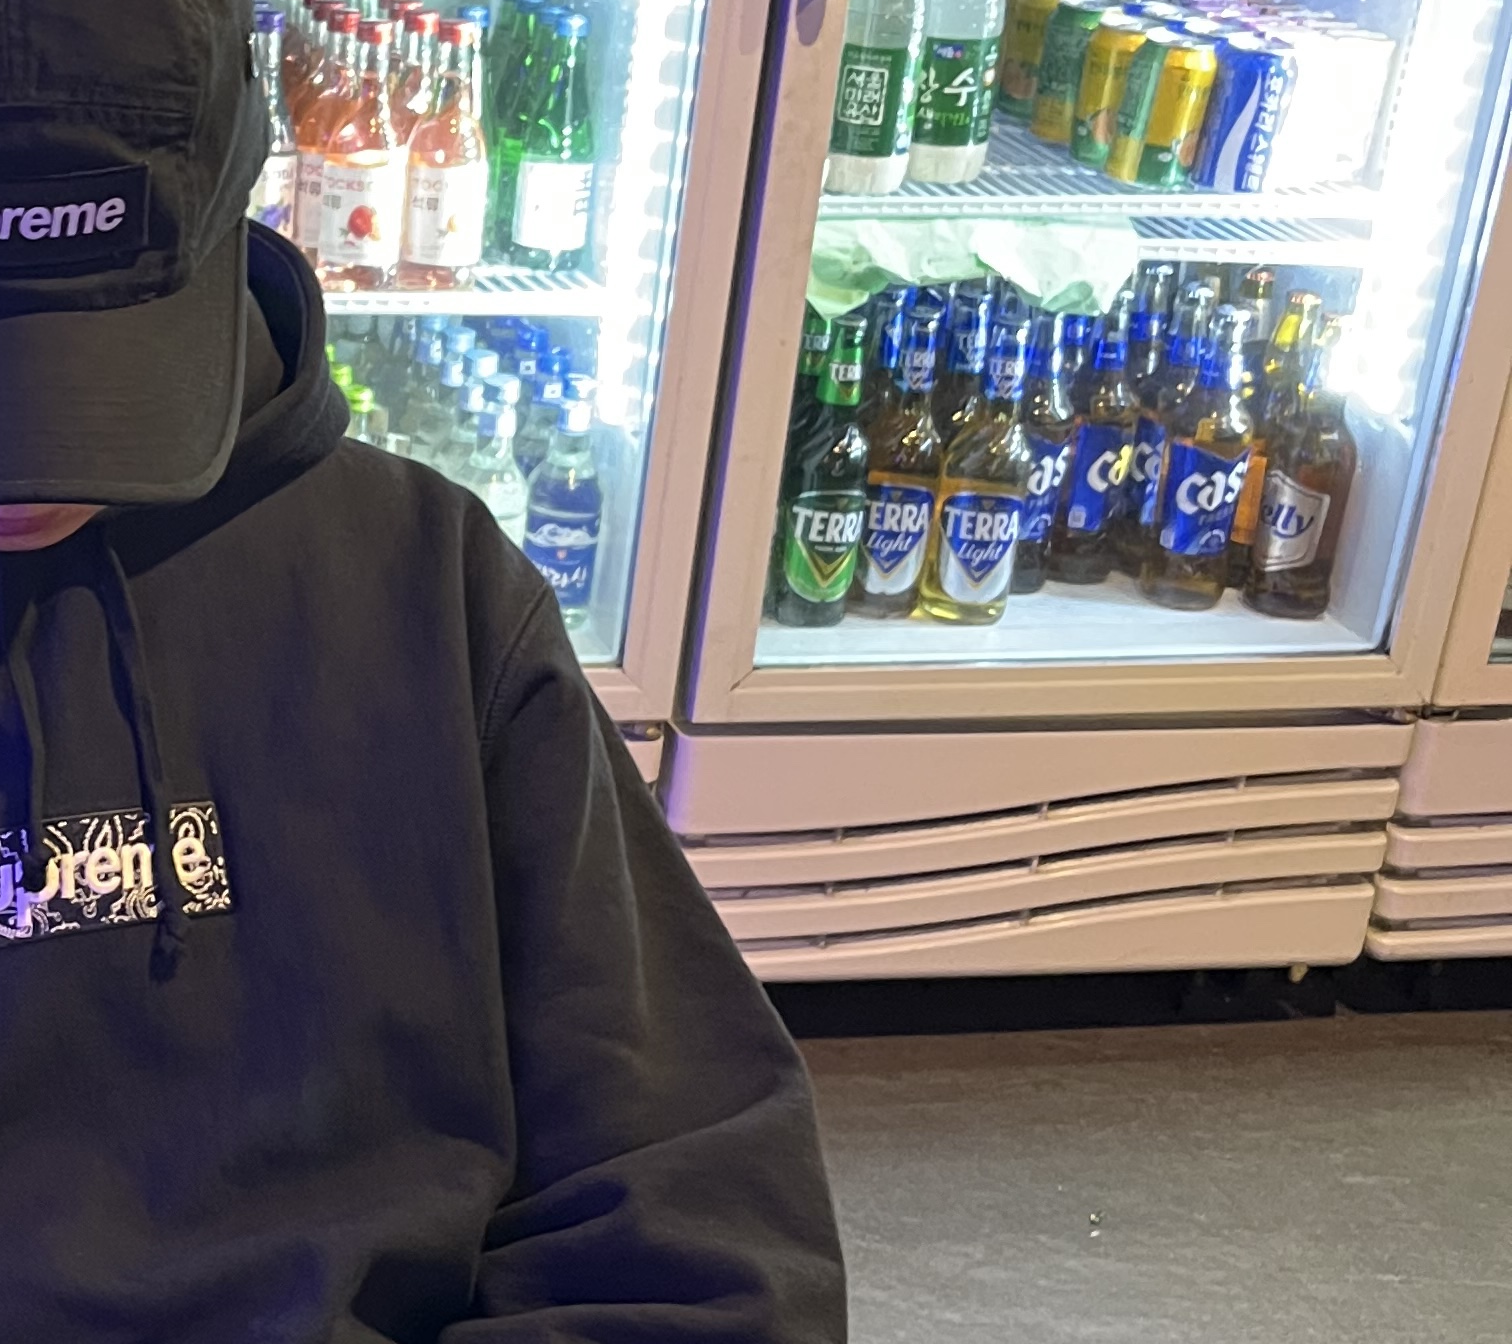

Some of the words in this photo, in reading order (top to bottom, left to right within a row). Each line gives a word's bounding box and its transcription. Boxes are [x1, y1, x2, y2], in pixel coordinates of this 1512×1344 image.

[792, 506, 864, 544] TERRA
[945, 504, 1020, 541] TERRA
[1262, 502, 1316, 540] elly
[866, 532, 913, 556] Light
[958, 539, 1006, 567] Light
